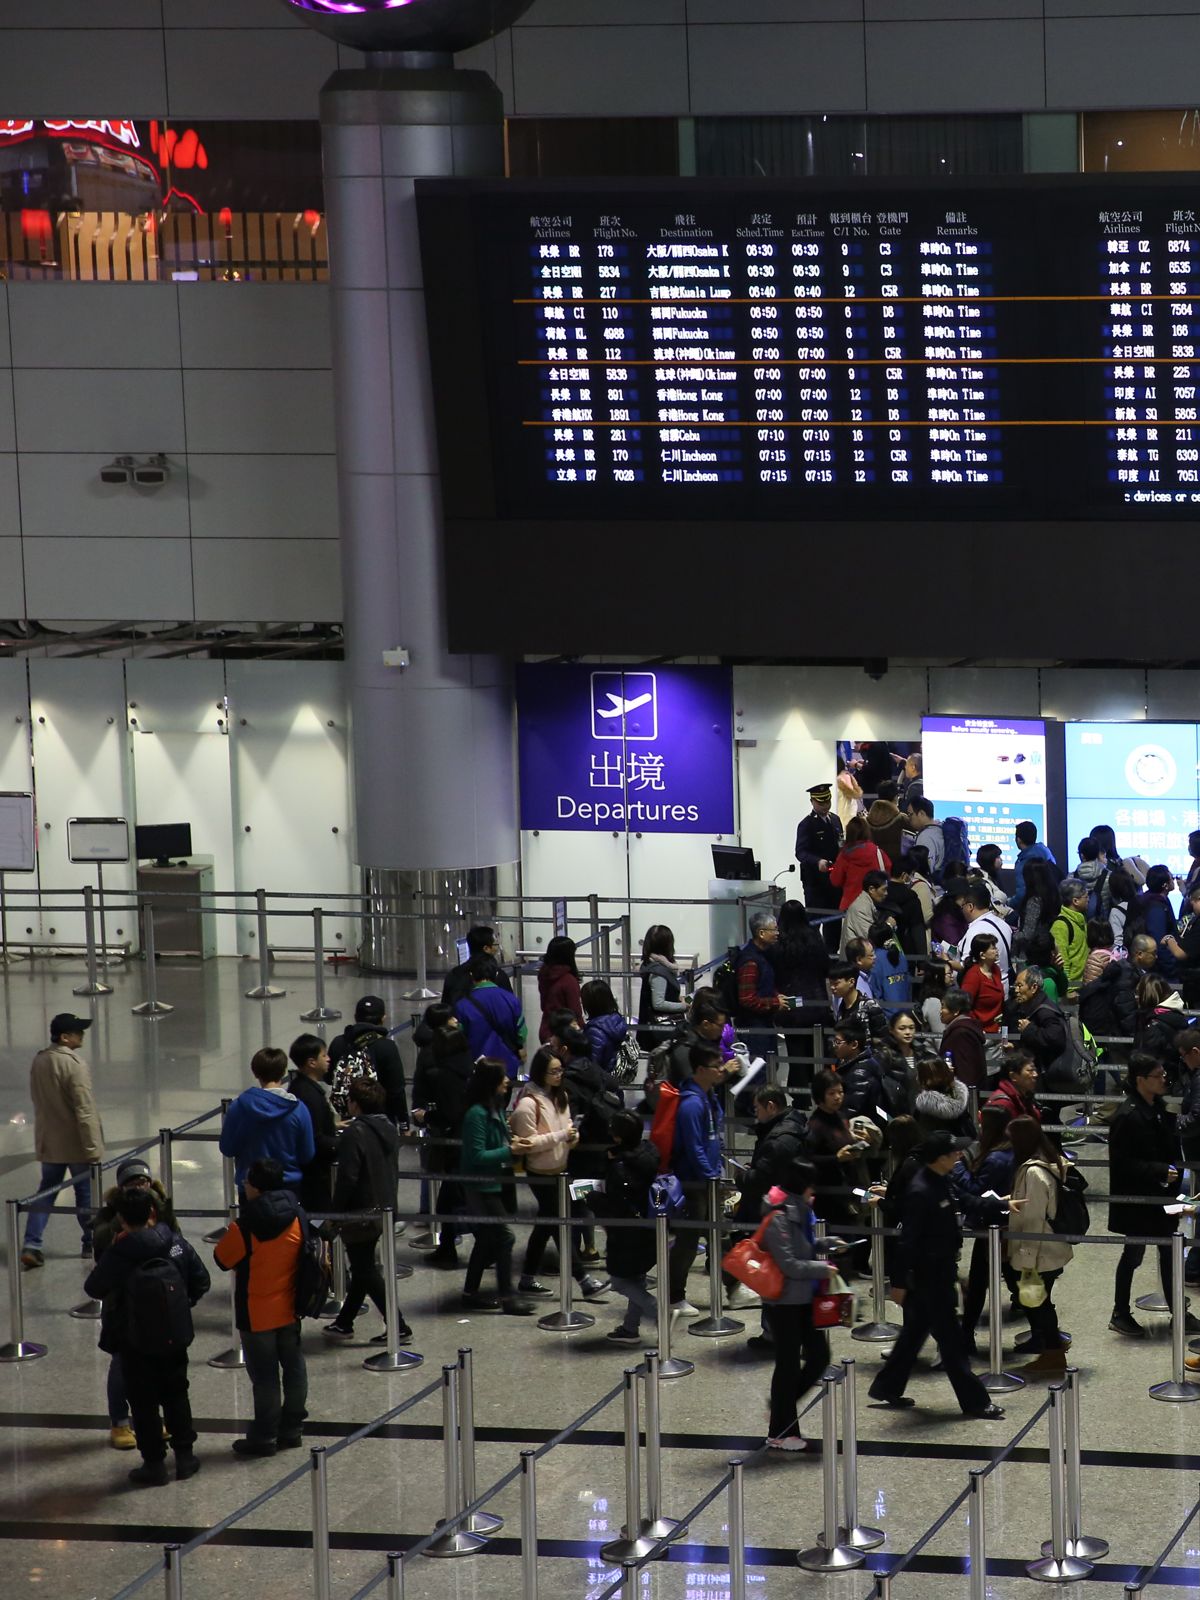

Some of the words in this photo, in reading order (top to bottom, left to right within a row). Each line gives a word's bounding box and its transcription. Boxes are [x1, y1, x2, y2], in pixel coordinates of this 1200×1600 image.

[529, 215, 573, 228] 航空公司
[599, 215, 621, 227] 班次
[675, 214, 696, 226] 飛往
[751, 213, 772, 225] 表定
[797, 213, 817, 226] 預計
[829, 211, 872, 224] 報到櫃台
[876, 211, 909, 224] 登機門
[945, 211, 967, 224] 備註
[1098, 210, 1143, 224] 航空公司
[1172, 209, 1196, 223] 班次
[535, 228, 571, 238] Airlines
[594, 228, 620, 239] Flight
[621, 228, 637, 237] No.
[660, 227, 713, 238] Destination
[736, 227, 784, 238] Sched.Time
[791, 228, 825, 237] Est.Time
[833, 226, 849, 237] C/I
[854, 226, 869, 236] No.
[879, 226, 902, 236] Gate
[936, 225, 978, 236] Remarks
[1103, 223, 1141, 234] Airlines
[1166, 222, 1193, 235] Flight
[1140, 262, 1151, 273] AC
[1169, 261, 1190, 273] 6535
[586, 470, 596, 481] B7
[613, 470, 634, 481] 7028
[662, 469, 718, 481] 仁川Incheon
[761, 470, 787, 481] 07:15
[805, 470, 832, 481] 07:15
[855, 470, 865, 481] 12
[892, 470, 908, 481] C5R
[966, 470, 988, 481] Time
[1119, 469, 1139, 482] 印度
[1149, 470, 1159, 481] AI
[1177, 470, 1198, 481] 7051
[1134, 491, 1172, 502] devices
[1175, 494, 1187, 502] or
[589, 751, 666, 791] 出境
[557, 796, 699, 826] Departures
